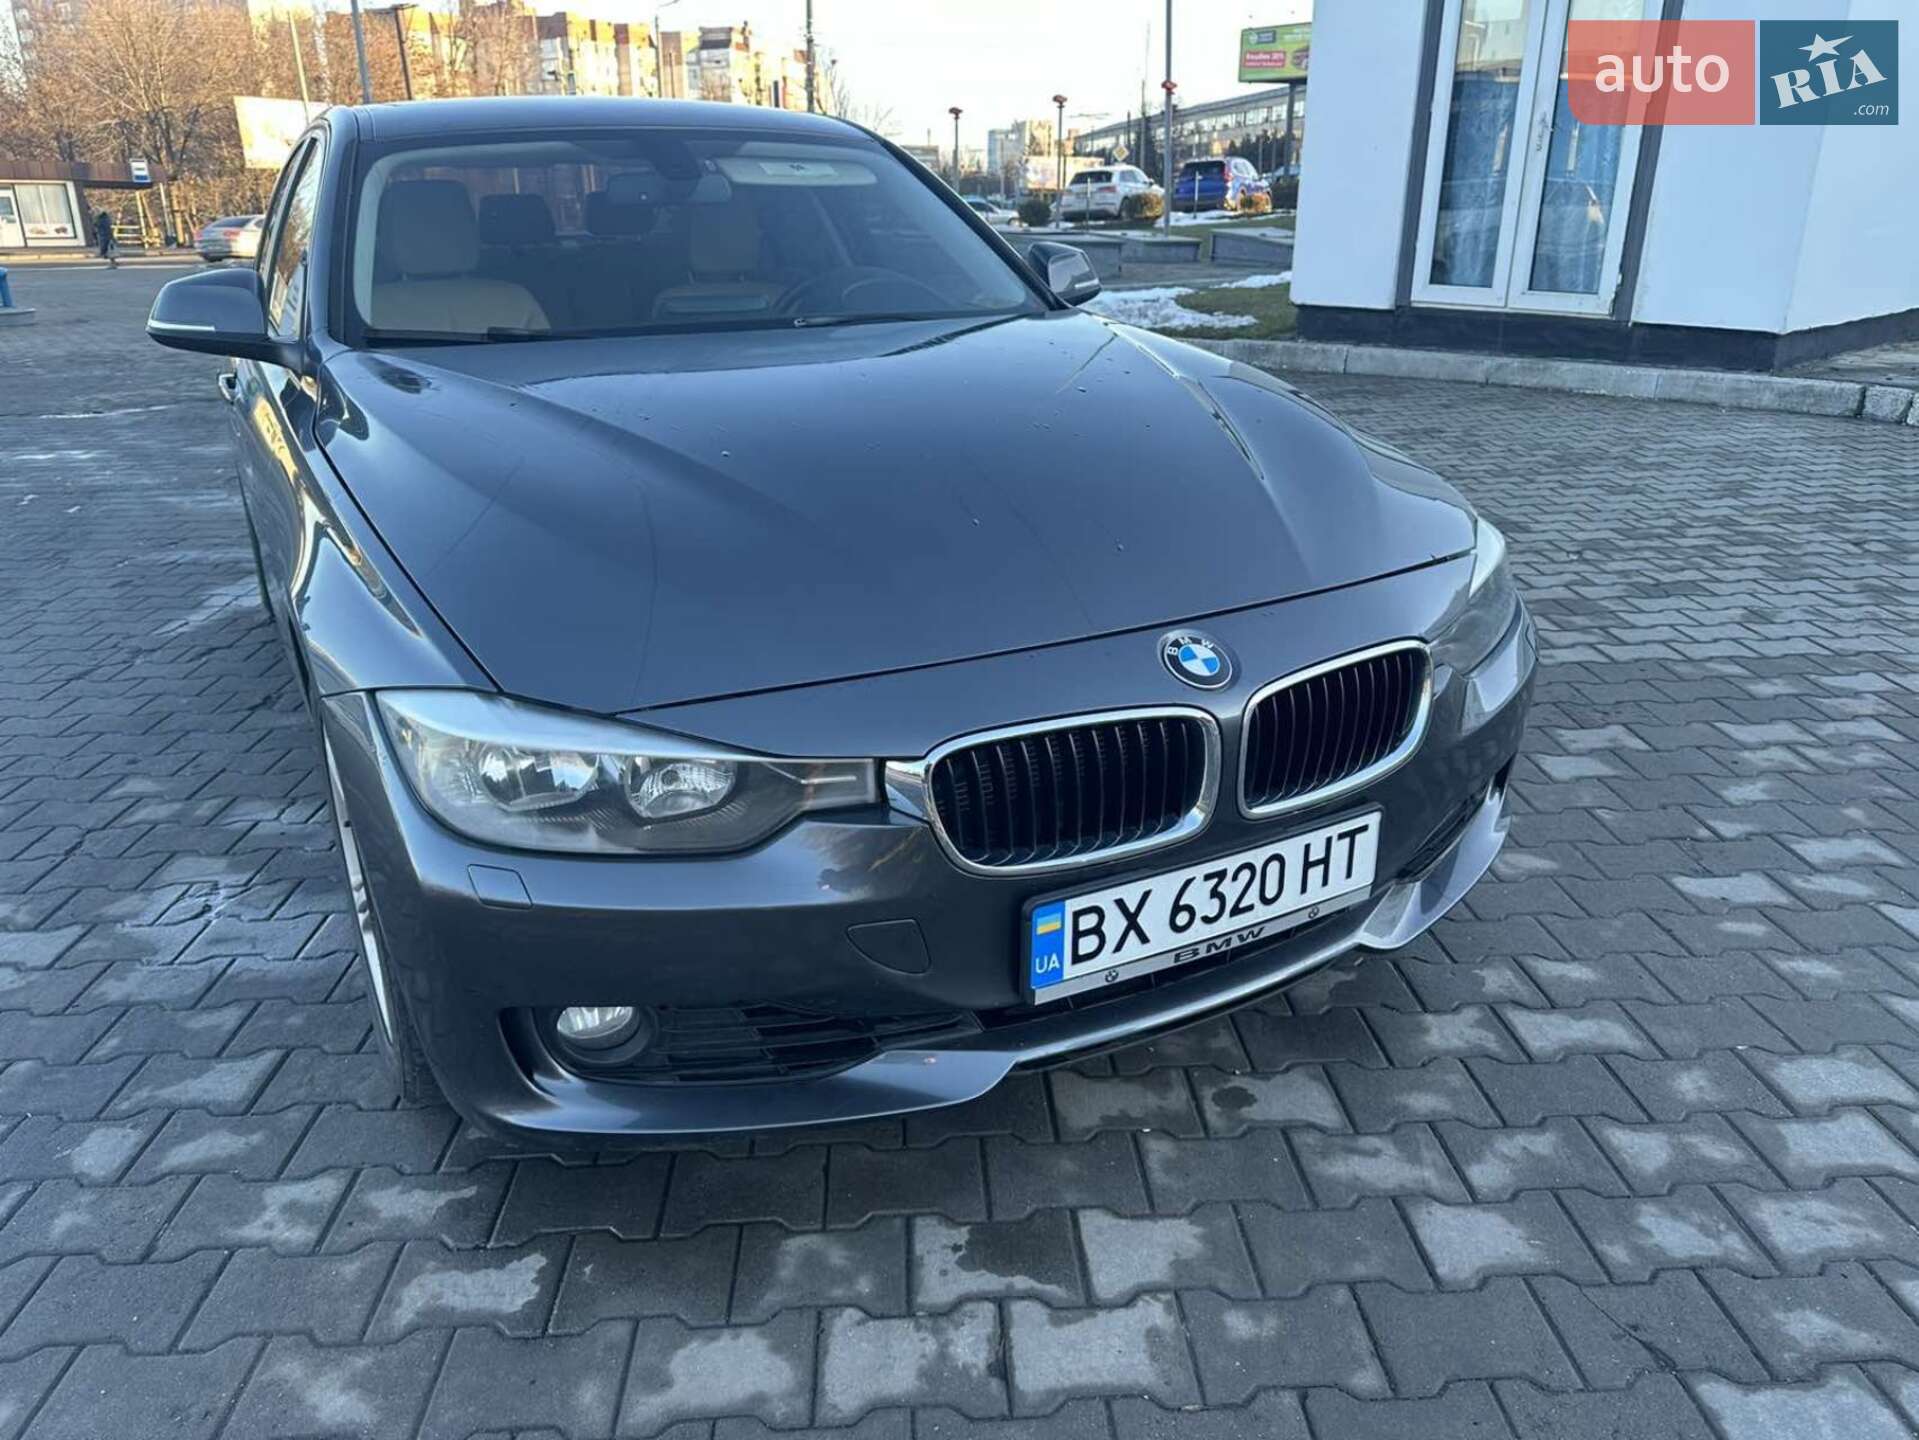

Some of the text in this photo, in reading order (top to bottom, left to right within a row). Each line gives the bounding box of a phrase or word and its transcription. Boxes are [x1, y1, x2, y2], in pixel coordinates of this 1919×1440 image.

[1070, 824, 1370, 966] BX 6320 HT
[1173, 926, 1266, 964] BMW
[1035, 955, 1060, 974] UA
